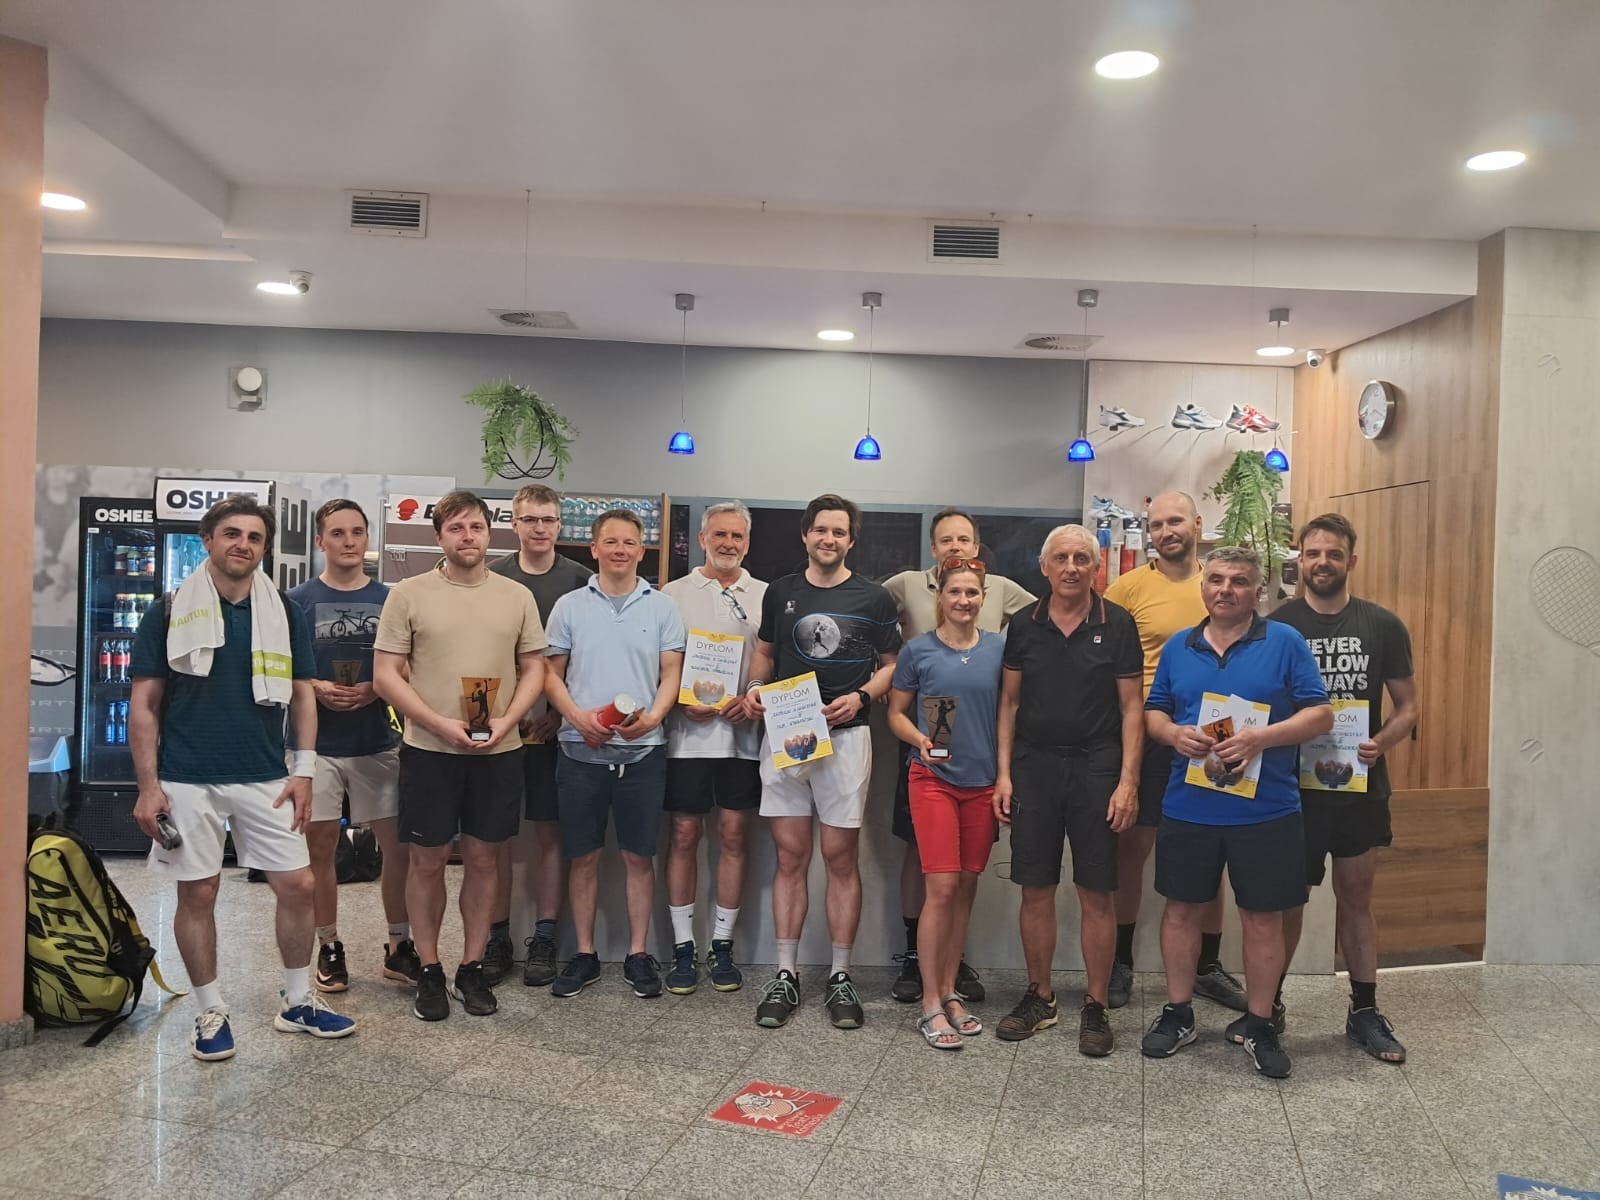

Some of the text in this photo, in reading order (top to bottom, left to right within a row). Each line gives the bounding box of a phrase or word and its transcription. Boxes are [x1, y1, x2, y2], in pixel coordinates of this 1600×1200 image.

[166, 490, 258, 509] OSH
[95, 508, 154, 523] OSHEE
[696, 641, 734, 653] DYPLOM
[1315, 654, 1370, 673] LLOW
[1321, 673, 1368, 691] WAYS
[771, 687, 810, 704] DYPLOM
